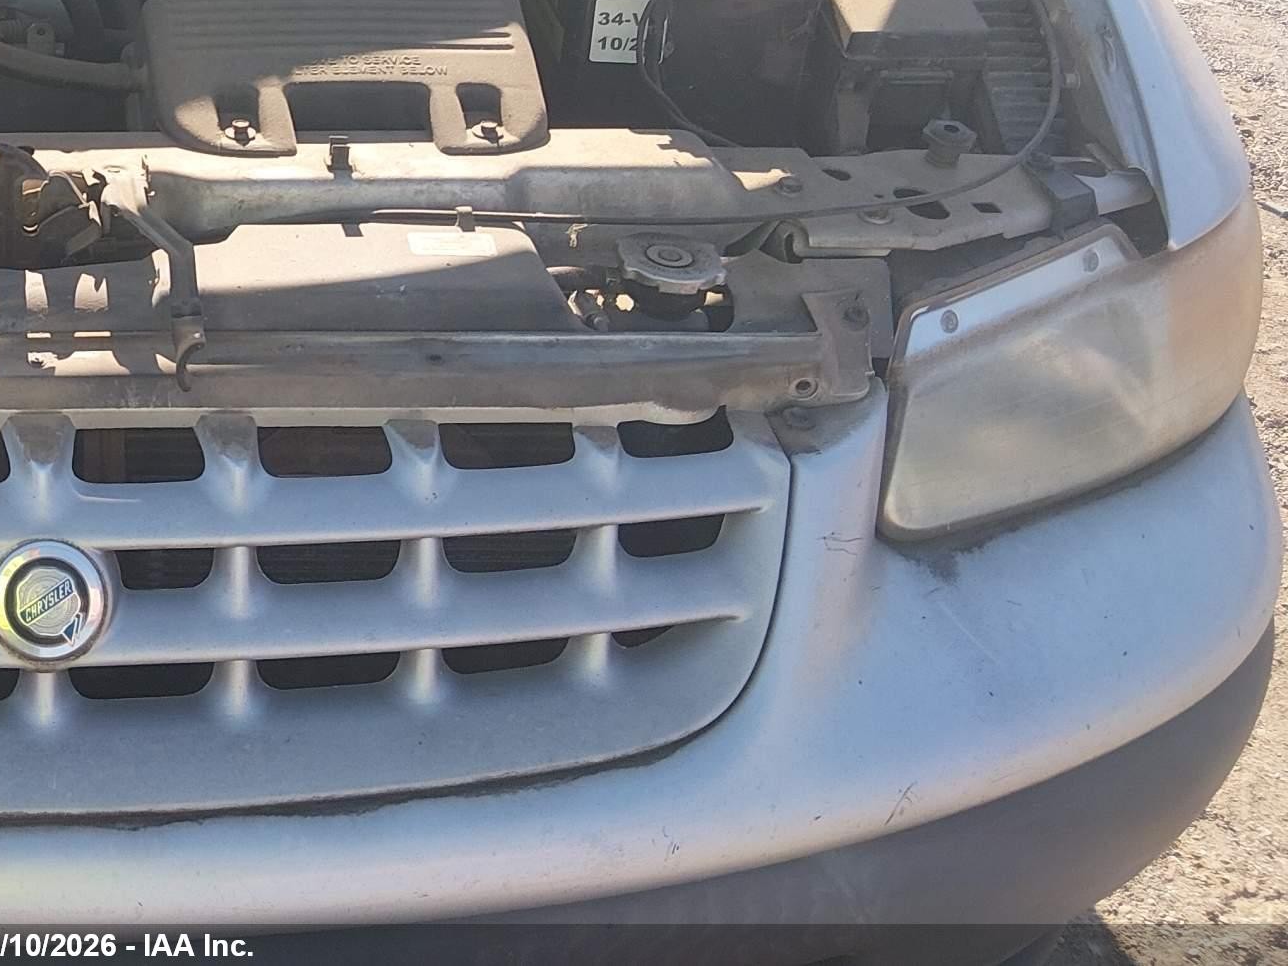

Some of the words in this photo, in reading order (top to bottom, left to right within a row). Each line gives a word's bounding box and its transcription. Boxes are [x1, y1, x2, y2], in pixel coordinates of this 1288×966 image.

[598, 12, 640, 26] 34-V
[598, 36, 638, 51] 10/2
[362, 54, 421, 66] SERVICE
[330, 65, 394, 75] ELEMENT
[400, 65, 447, 75] BELOW
[25, 580, 72, 622] CHRYSLER
